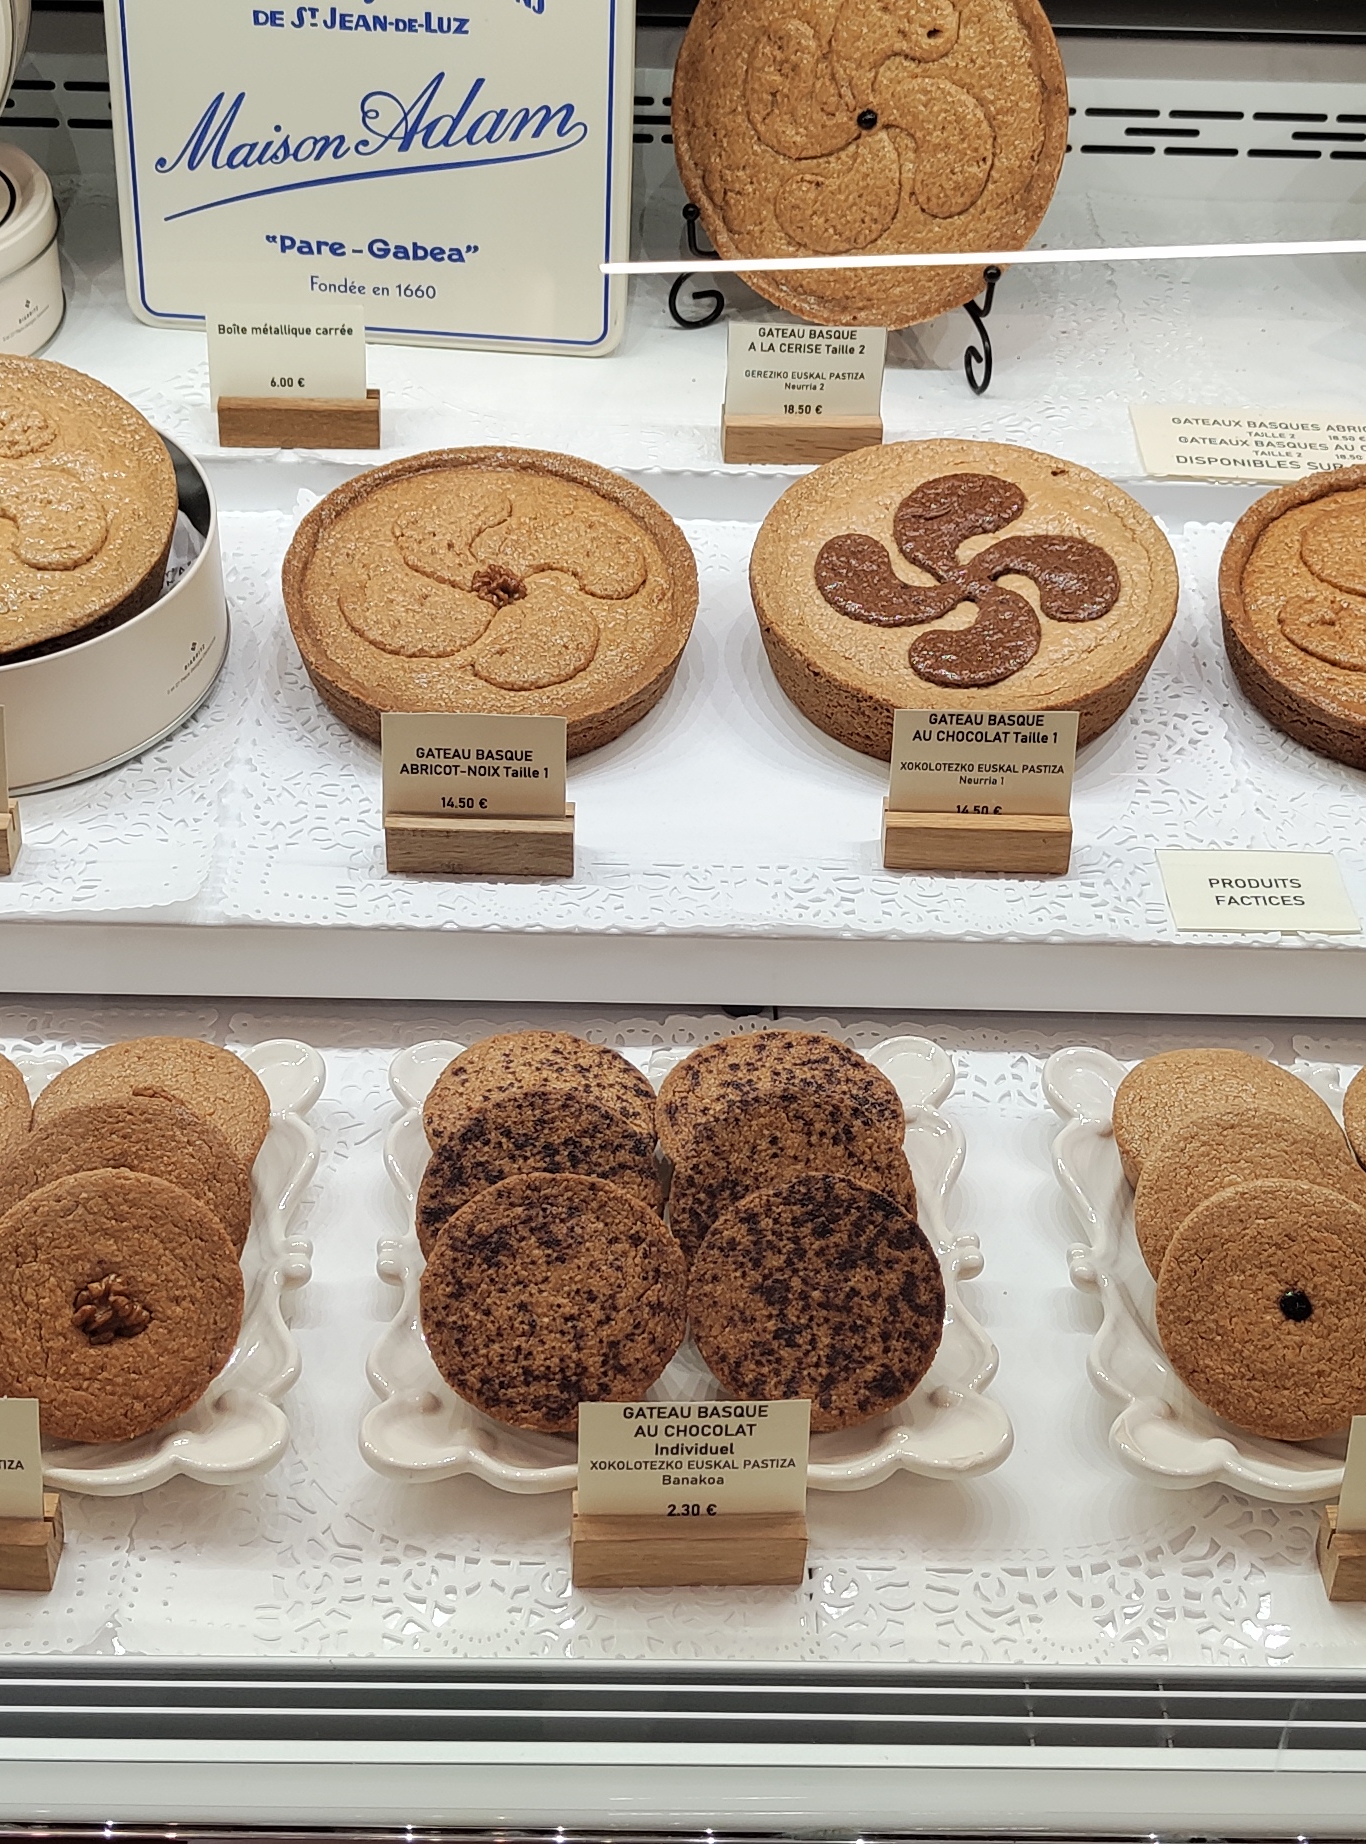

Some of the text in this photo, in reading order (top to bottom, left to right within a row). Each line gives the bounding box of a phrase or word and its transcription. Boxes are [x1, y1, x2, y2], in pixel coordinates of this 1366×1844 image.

[252, 11, 284, 28] DE
[323, 8, 470, 35] JEAN-DE-LUZ
[155, 71, 587, 173] Maison Adam
[310, 276, 436, 300] Fondée en 1660
[218, 324, 353, 337] Boîte métallique carrée
[758, 328, 857, 340] GATEAU BASQUE
[748, 342, 865, 354] A LA CERISE Taille 2
[745, 370, 865, 380] GEREZIKO EUSKAL PASTIZA
[270, 378, 305, 387] 6.00 €
[1172, 418, 1243, 427] GATEAUX
[1247, 421, 1320, 431] BASQUES
[1179, 437, 1250, 446] GATEAUX
[1255, 440, 1329, 450] BASQUES
[1176, 455, 1300, 469] DISPONIBLES
[912, 731, 1057, 743] AU CHOCOLAT Taille 1
[400, 764, 548, 778] ABRICOT-NOIX Taille 1
[900, 762, 1064, 774] XOKOLOTEZKO EUSKAL PASTIZA
[1209, 878, 1302, 889] PRODUITS
[1215, 896, 1305, 906] FACTICES
[634, 1424, 757, 1437] AU CHOCOLAT
[655, 1443, 734, 1455] Individuel
[590, 1459, 796, 1471] XOKOLOTEZKO EUSKAL PASTIZA
[662, 1475, 724, 1485] Banakoa
